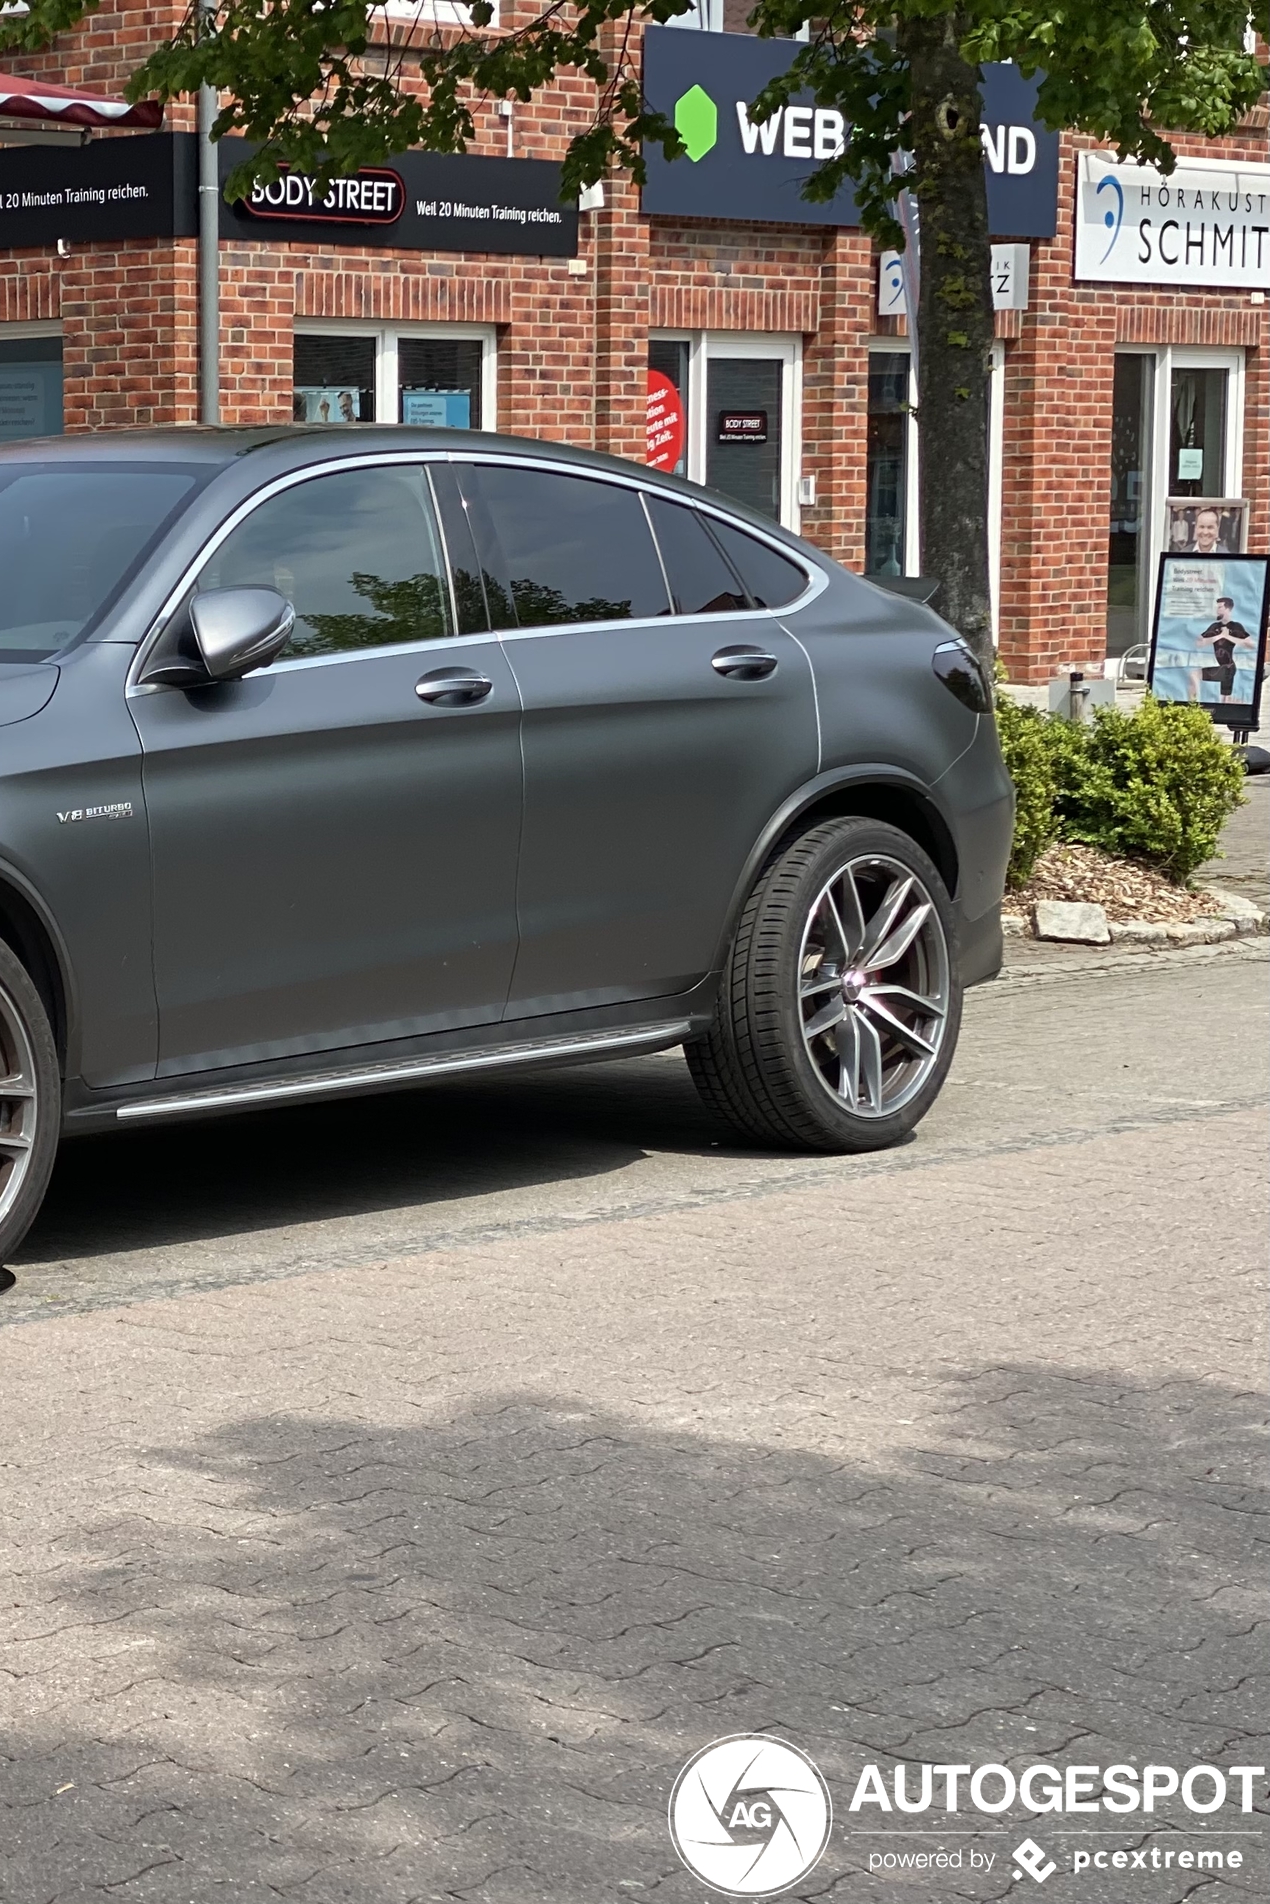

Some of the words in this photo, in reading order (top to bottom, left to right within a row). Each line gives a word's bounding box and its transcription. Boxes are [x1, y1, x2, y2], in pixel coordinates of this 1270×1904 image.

[5, 193, 20, 209] 20
[22, 191, 63, 207] Minuten
[64, 187, 105, 204] Training
[107, 182, 149, 200] reichen.
[252, 174, 317, 207] BODY
[323, 178, 396, 212] STREET
[1140, 181, 1267, 214] HÖRAKUST
[416, 200, 437, 217] Weil
[438, 202, 452, 218] 20
[453, 202, 490, 220] Minuten
[491, 204, 527, 225] Training
[527, 208, 563, 224] reichen.
[1138, 217, 1269, 269] SCHMIT
[725, 419, 742, 428] BODY
[742, 419, 761, 428] STREET
[56, 809, 84, 823] V8
[86, 802, 132, 816] BITURBO
